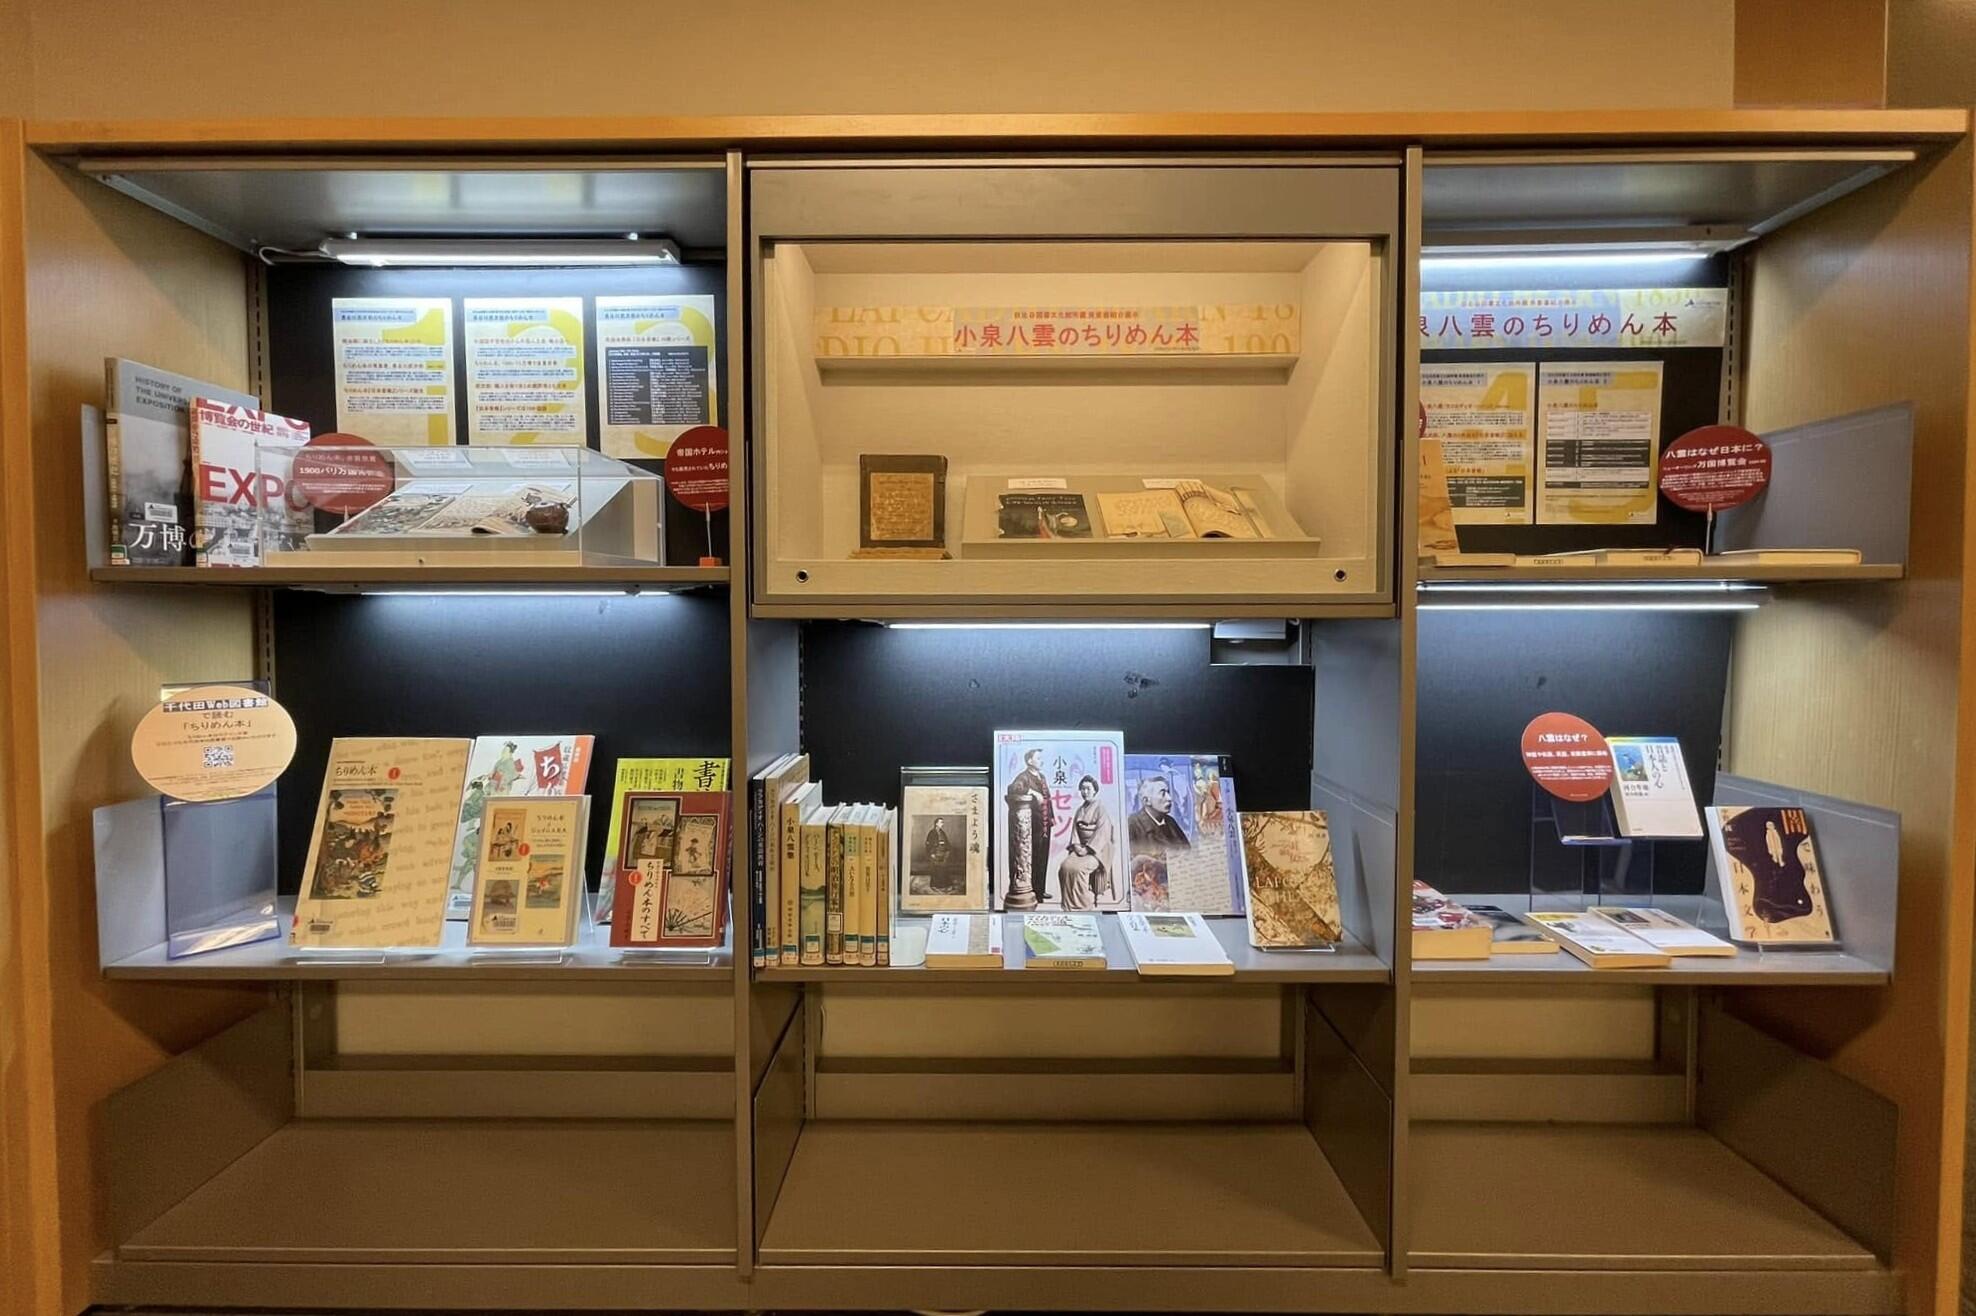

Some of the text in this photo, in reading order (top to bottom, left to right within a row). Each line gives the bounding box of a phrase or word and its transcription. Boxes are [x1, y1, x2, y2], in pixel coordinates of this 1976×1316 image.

[954, 323, 1200, 347] 小泉八雲のちりめん本
[135, 376, 171, 392] HISTORY
[136, 386, 152, 396] THE
[200, 410, 275, 436] 博覧会の世紀
[199, 462, 313, 517] EXPO
[163, 697, 270, 712] 千代田Web図書館
[203, 711, 235, 720] で読む
[184, 720, 253, 732] 「ちりめん本」
[540, 755, 561, 780] ち
[969, 793, 981, 854] さまよう魂
[639, 860, 656, 940] ちりめん本のすべて
